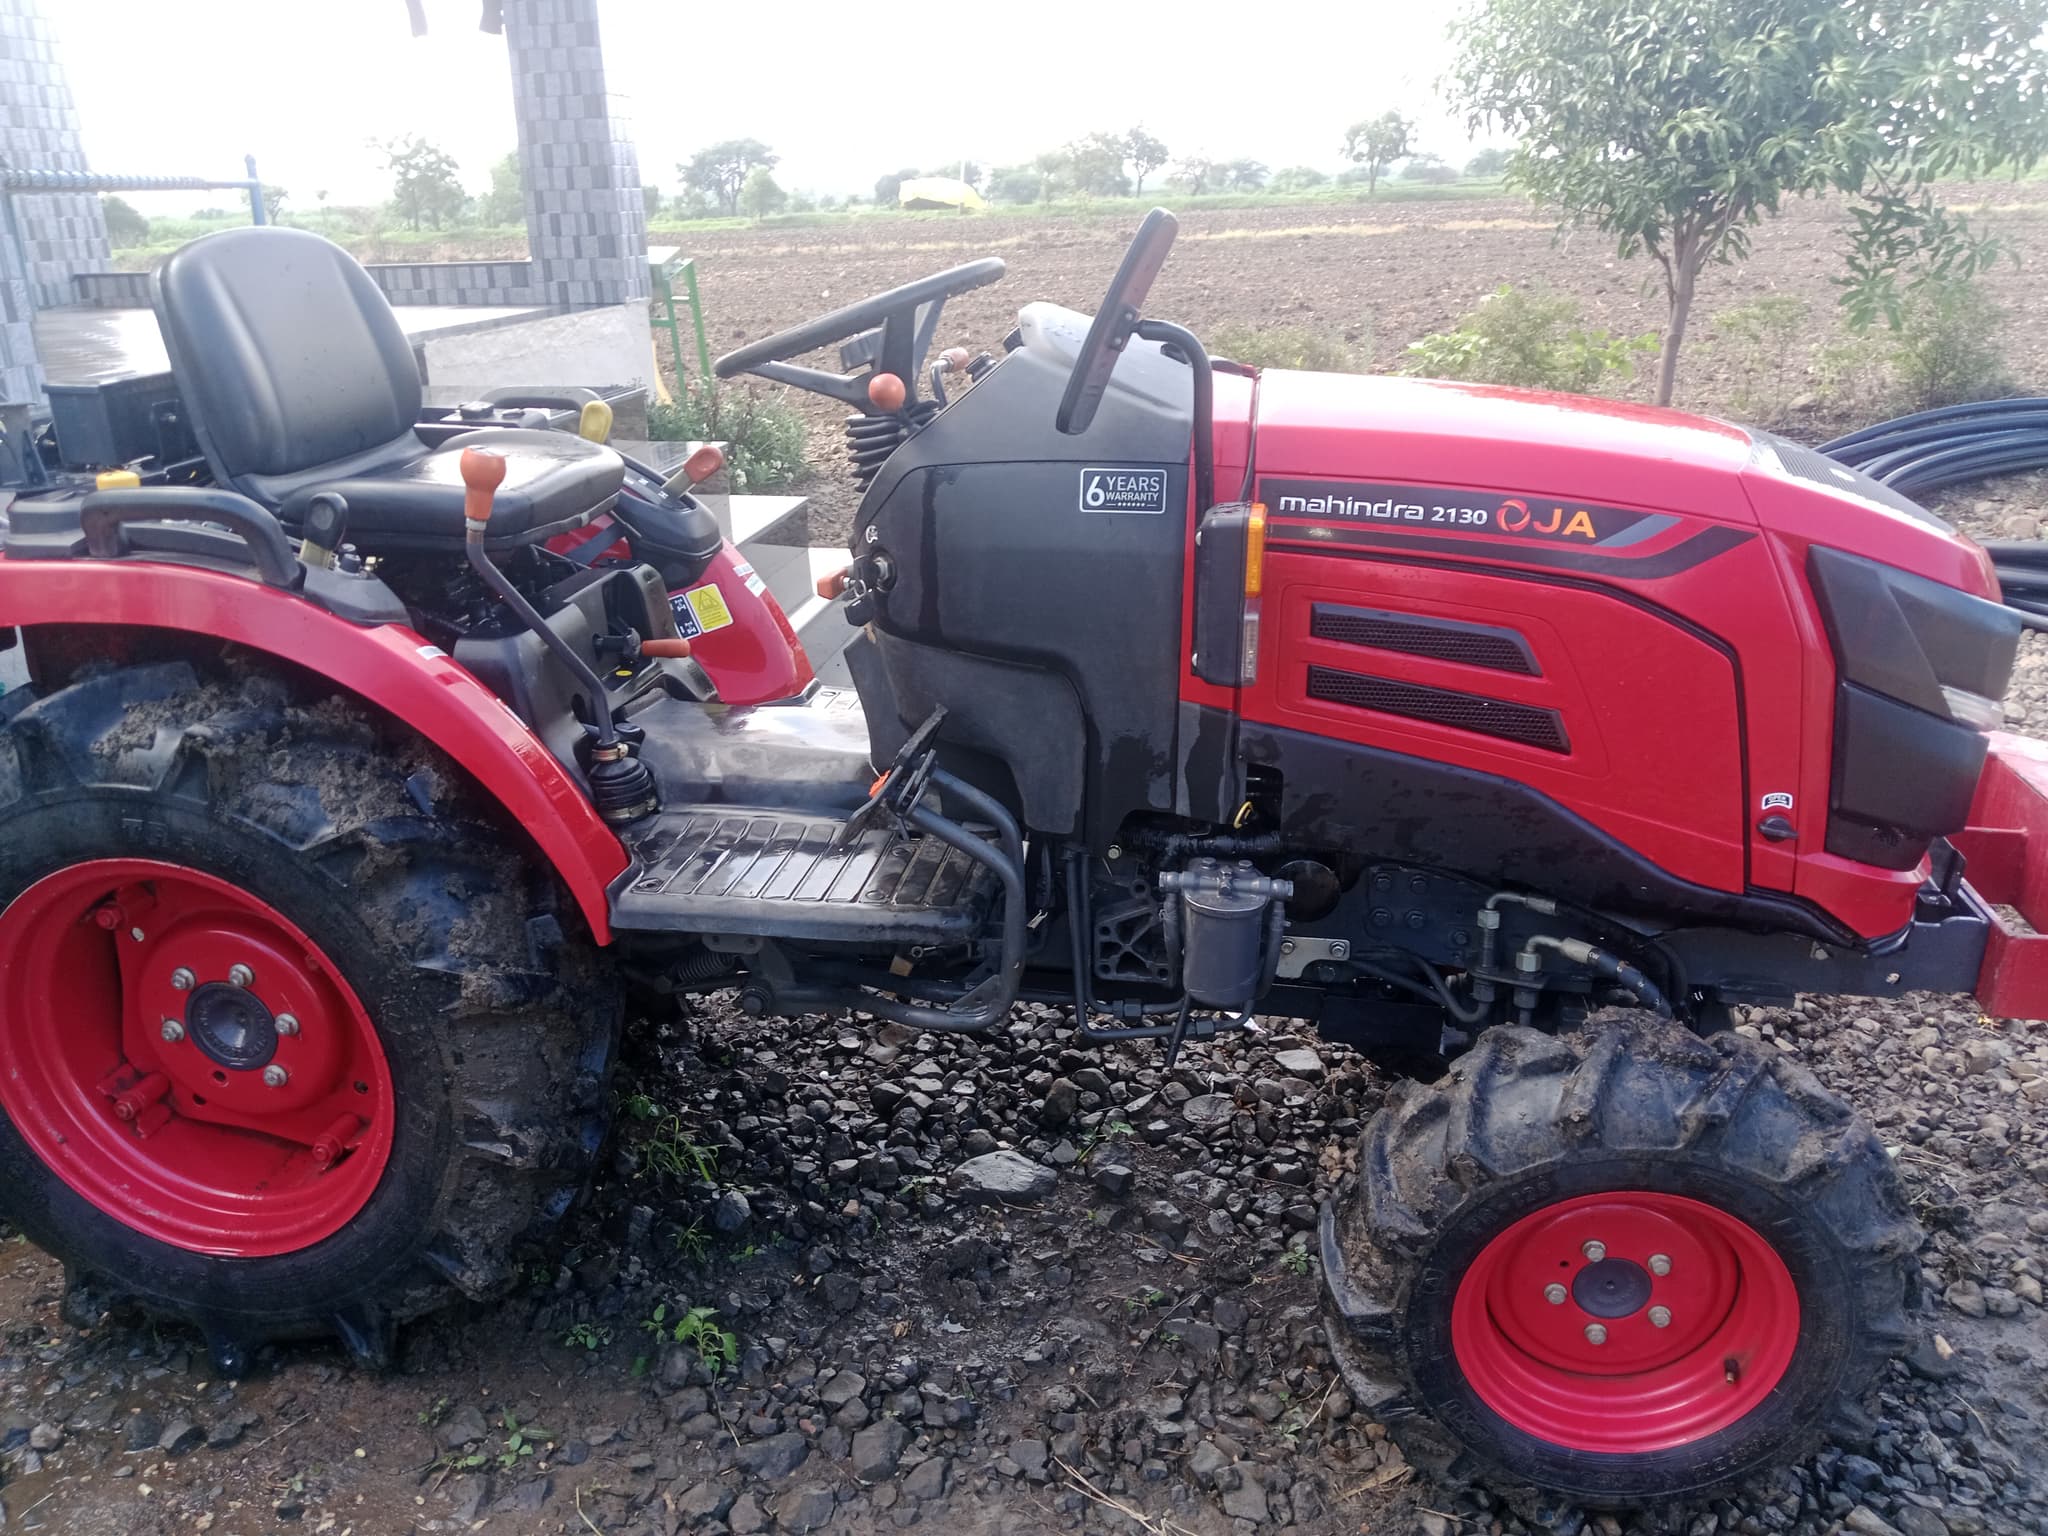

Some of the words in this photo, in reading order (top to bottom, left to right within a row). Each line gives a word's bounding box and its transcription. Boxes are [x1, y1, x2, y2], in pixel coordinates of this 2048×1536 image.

[1086, 476, 1105, 507] 6
[1106, 476, 1160, 492] YEARS
[1105, 491, 1160, 502] WARRANTY
[1279, 494, 1424, 521] mahindra
[1430, 505, 1488, 526] 2130
